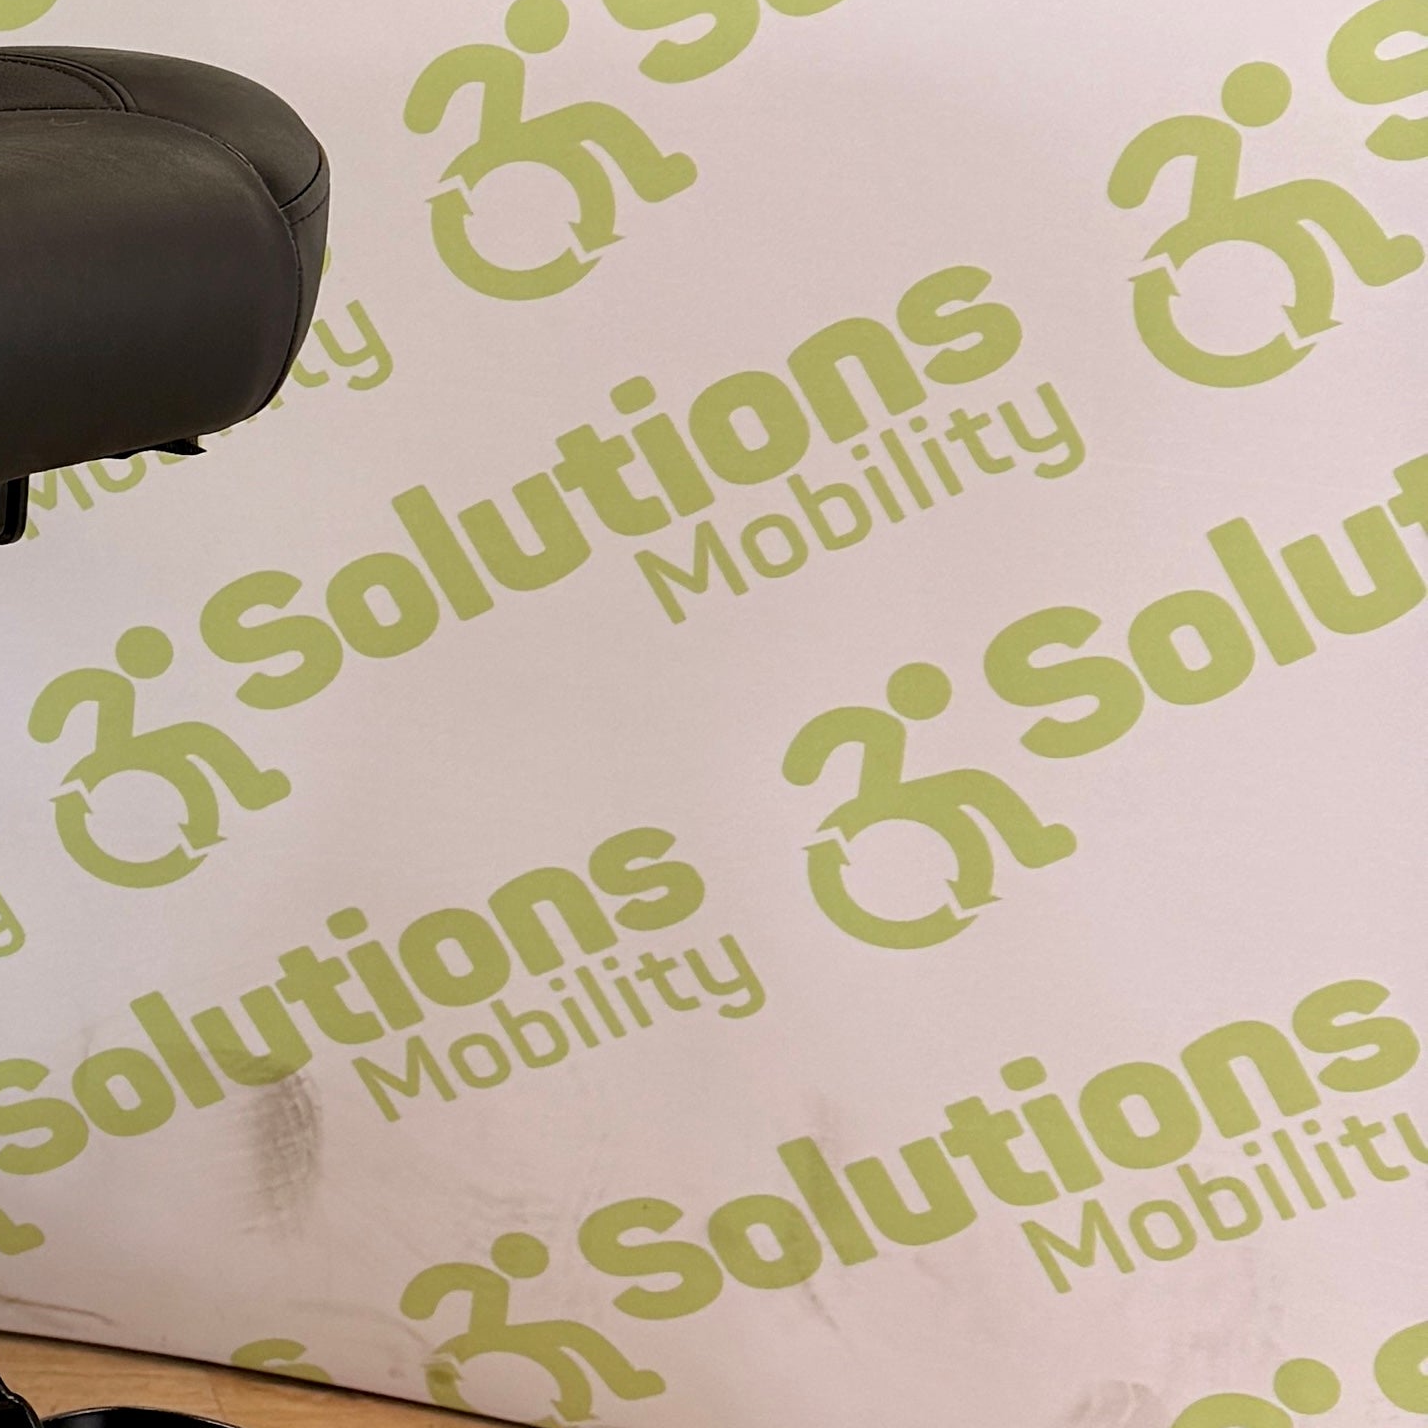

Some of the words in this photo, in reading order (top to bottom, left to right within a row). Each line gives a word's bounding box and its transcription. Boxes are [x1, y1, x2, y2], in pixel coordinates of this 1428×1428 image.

[201, 267, 1021, 709] Solutions
[637, 385, 1084, 622] Mobility
[354, 937, 764, 1121] Mobility
[579, 981, 1418, 1319] Solutions
